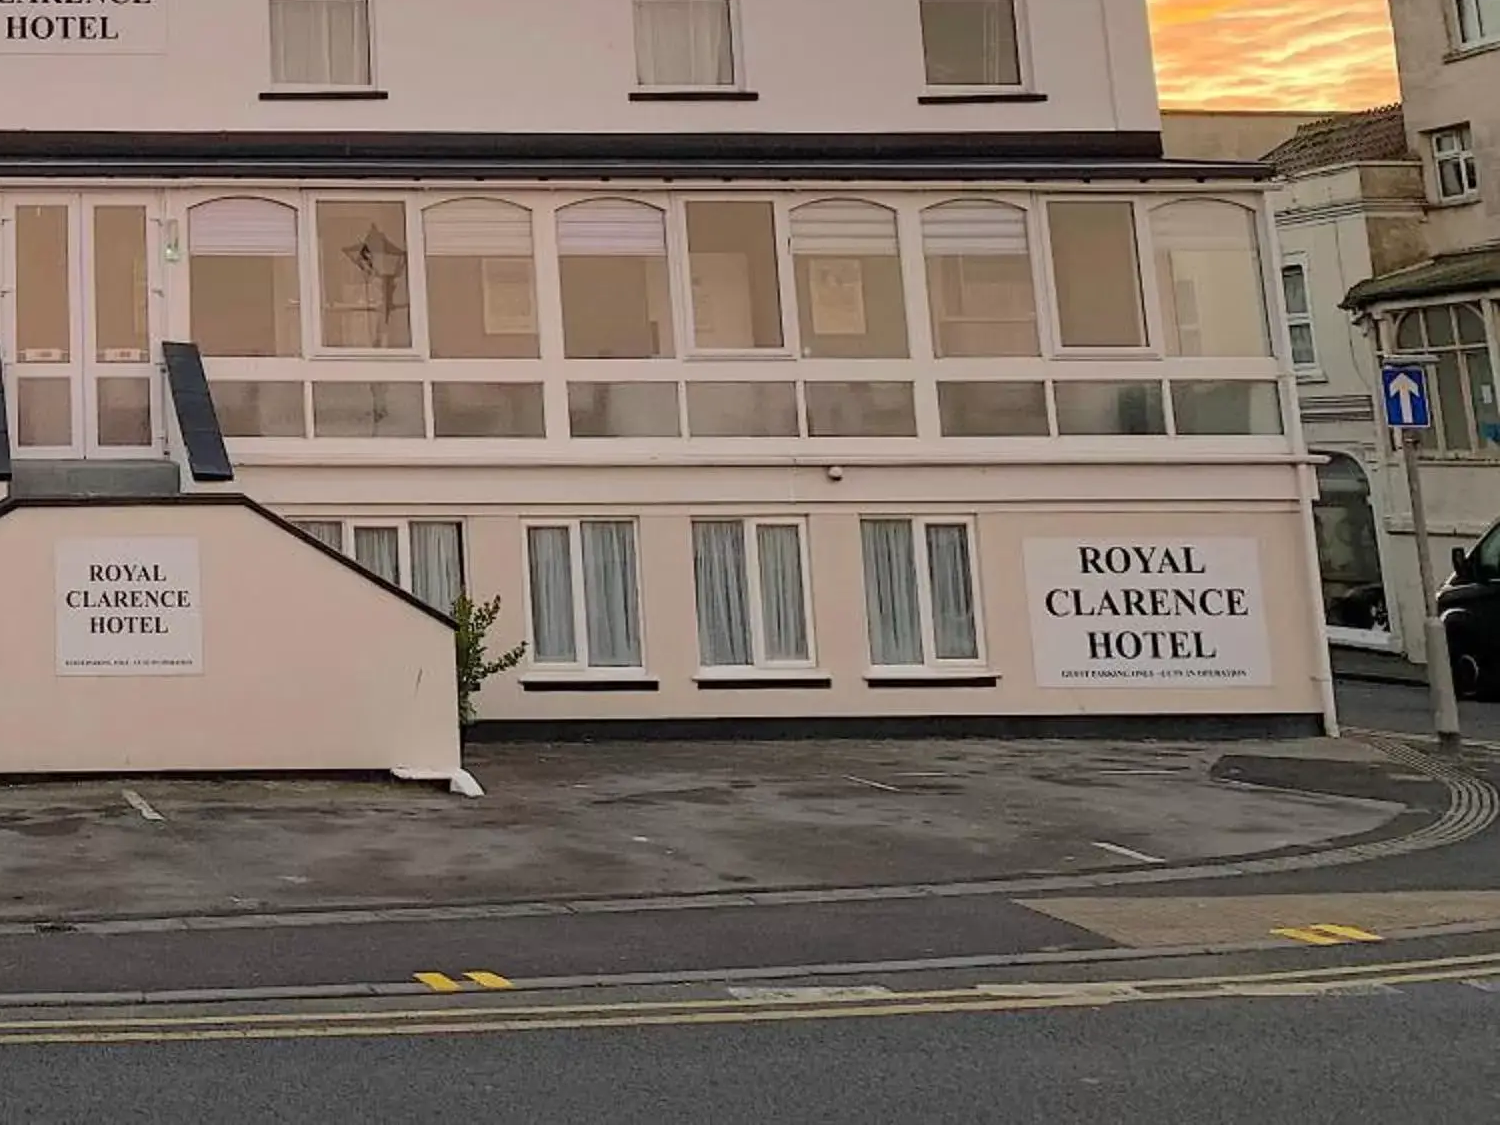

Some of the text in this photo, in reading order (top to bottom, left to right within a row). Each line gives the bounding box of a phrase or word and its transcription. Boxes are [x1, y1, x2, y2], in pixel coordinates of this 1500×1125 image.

[6, 16, 119, 39] HOTEL
[1078, 546, 1206, 574] ROYAL
[89, 564, 167, 582] ROYAL
[65, 590, 191, 608] CLARENCE
[1045, 588, 1249, 617] CLARENCE
[90, 616, 169, 633] HOTEL
[1087, 630, 1217, 659] HOTEL
